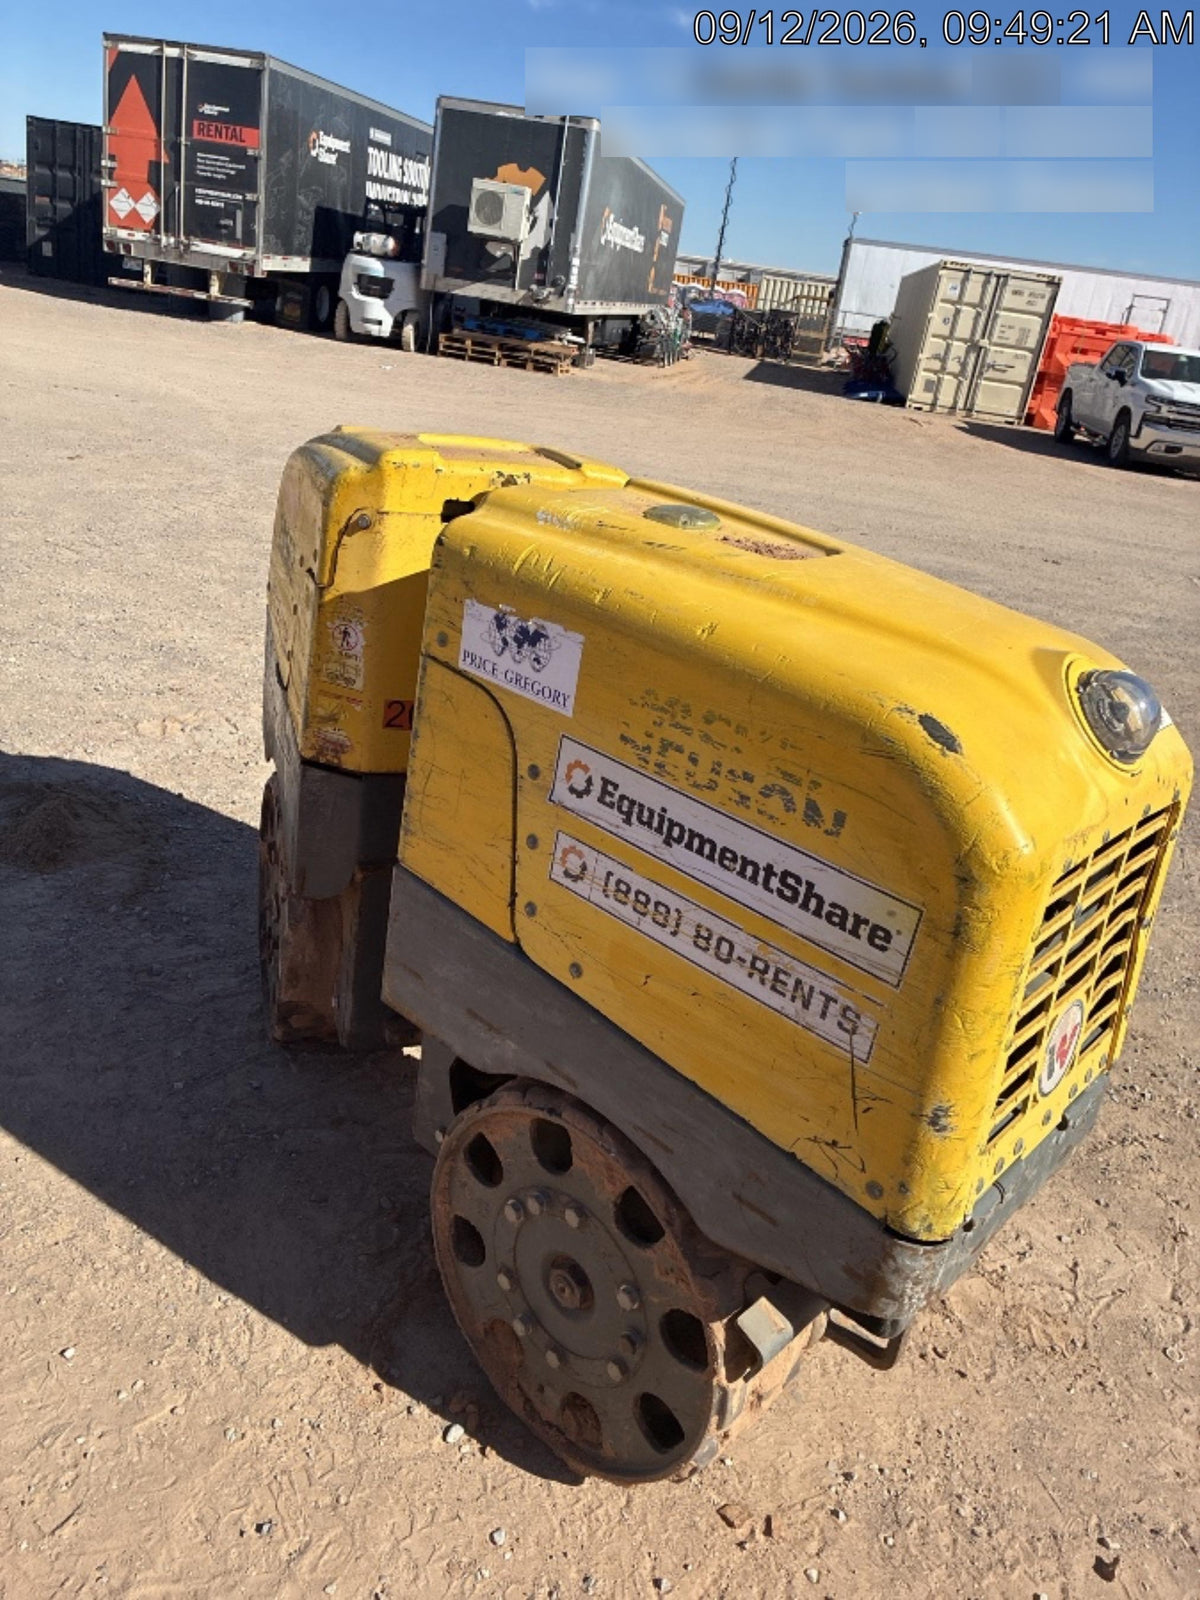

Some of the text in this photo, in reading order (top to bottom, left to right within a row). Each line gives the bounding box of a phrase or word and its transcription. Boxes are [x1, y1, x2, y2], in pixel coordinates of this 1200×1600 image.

[197, 121, 246, 143] RENTAL
[462, 648, 571, 708] PRICE GREGORY
[385, 699, 416, 729] 2
[597, 775, 894, 953] EquipmentShare
[602, 869, 862, 1037] (888) 80-RENTS
